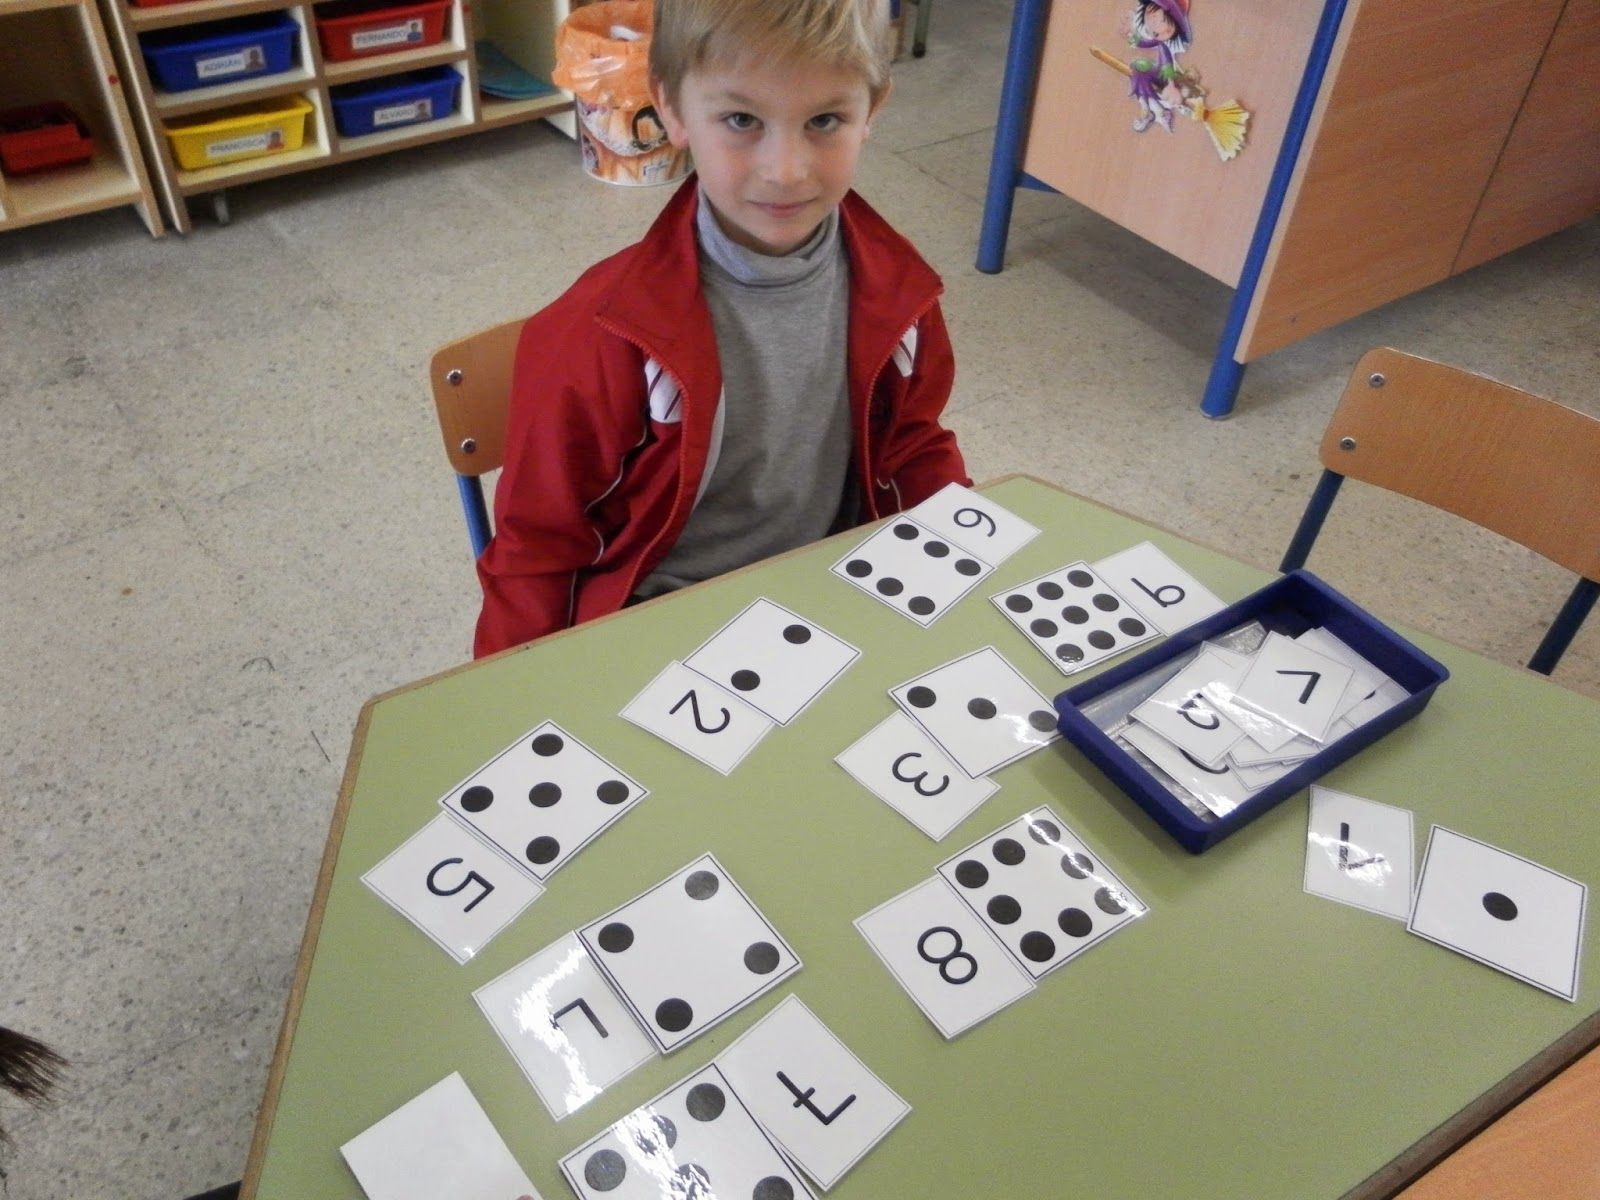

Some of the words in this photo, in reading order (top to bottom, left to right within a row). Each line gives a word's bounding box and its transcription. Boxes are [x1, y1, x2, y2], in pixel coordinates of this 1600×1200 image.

[355, 29, 407, 45] FERNANDO
[953, 508, 996, 537] 6
[669, 689, 731, 734] 2
[891, 752, 950, 797] 3
[426, 857, 495, 913] 5
[917, 926, 979, 985] 8
[776, 1070, 857, 1126] 7
